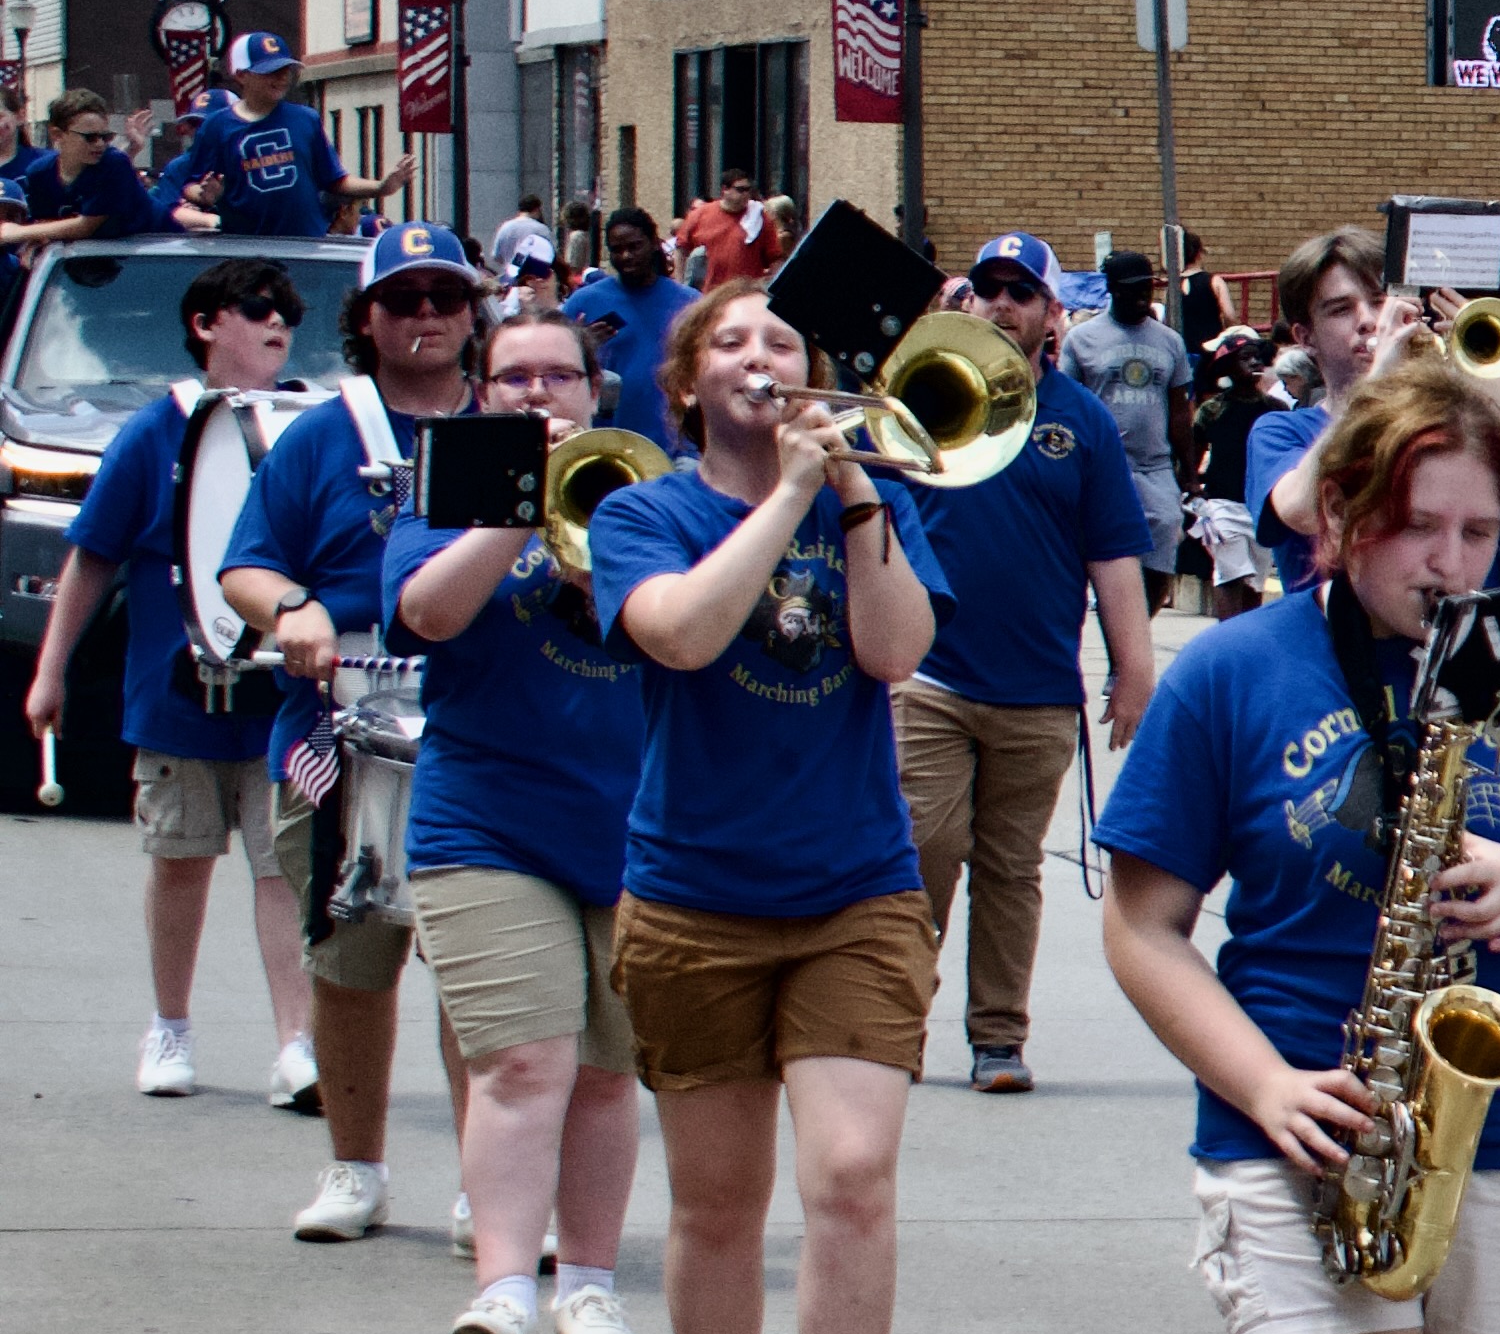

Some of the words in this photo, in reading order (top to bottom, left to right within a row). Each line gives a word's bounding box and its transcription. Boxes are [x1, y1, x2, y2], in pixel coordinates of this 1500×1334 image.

[838, 43, 900, 95] WELCOME
[403, 227, 434, 256] C
[1000, 236, 1023, 257] C
[540, 640, 617, 682] Marching
[730, 663, 820, 707] Marching
[821, 665, 854, 696] Ban
